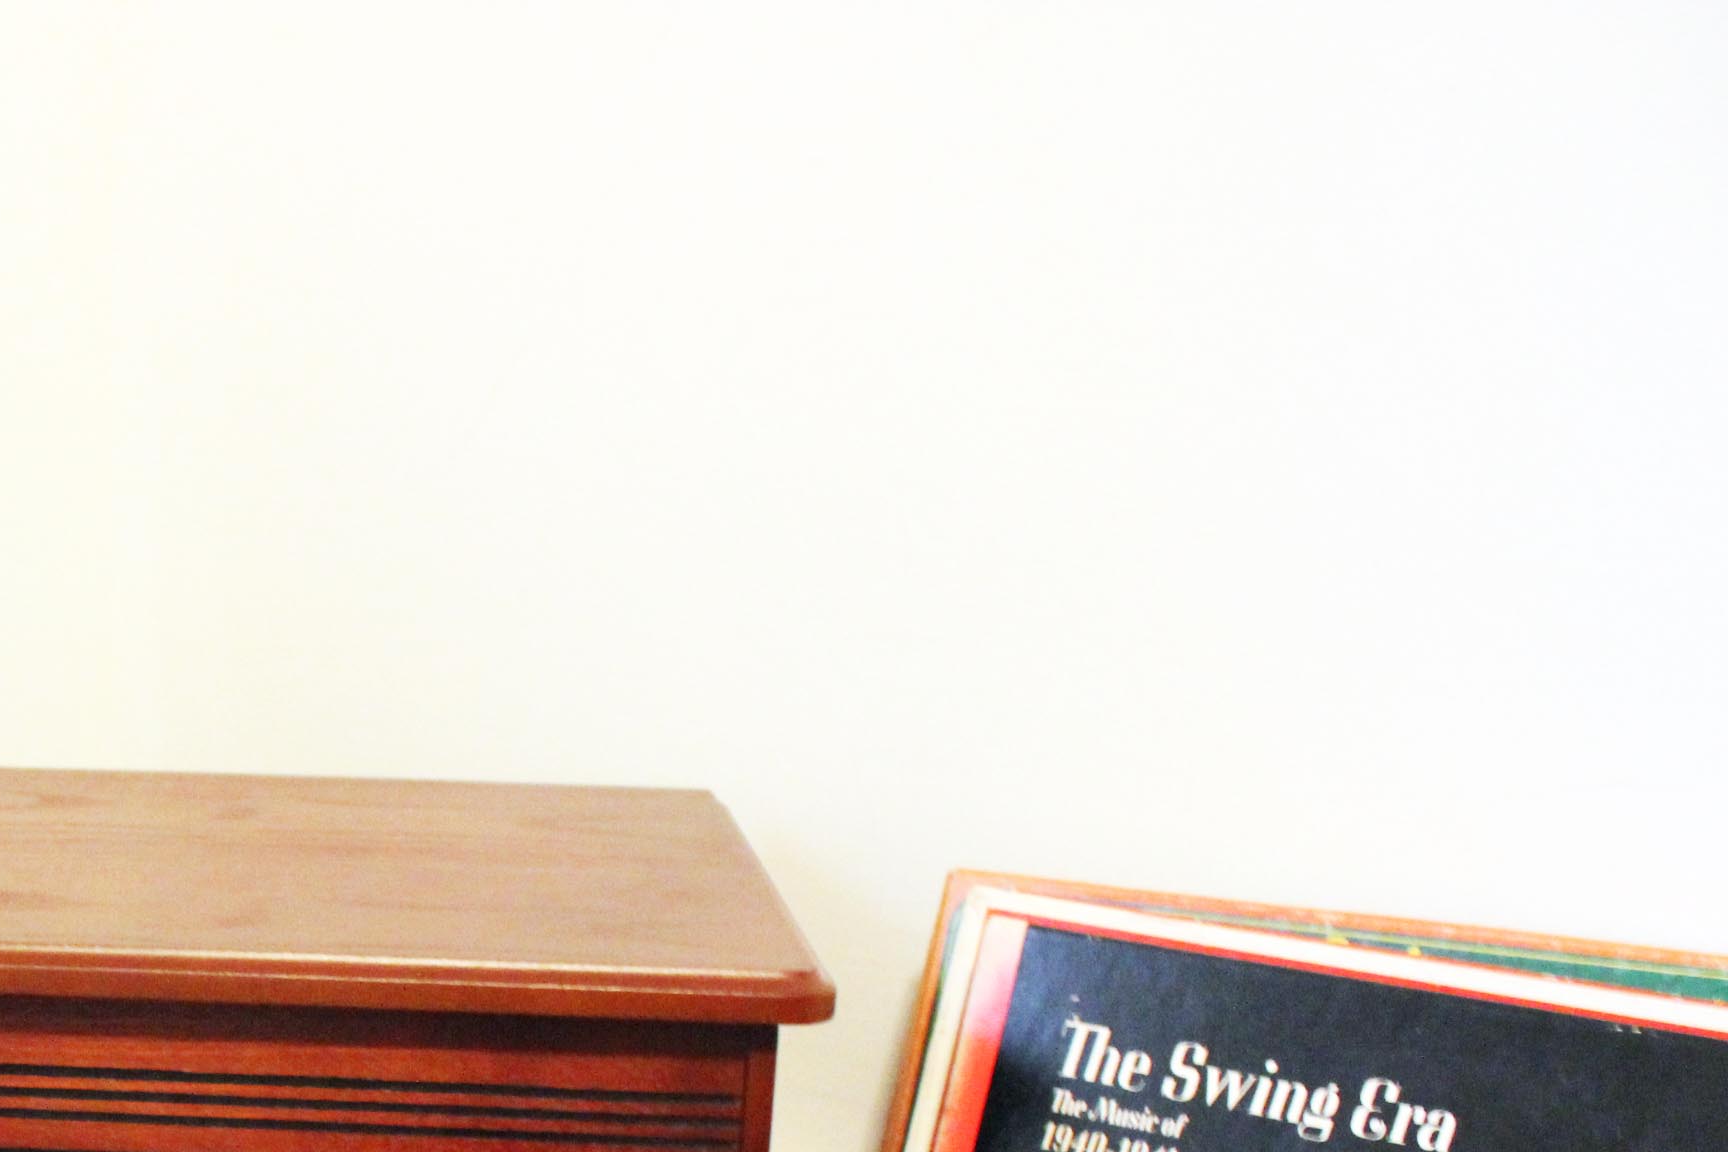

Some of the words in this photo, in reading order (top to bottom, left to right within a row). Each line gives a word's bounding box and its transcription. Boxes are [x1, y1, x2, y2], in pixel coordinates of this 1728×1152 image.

[1051, 1087, 1088, 1118] The
[1087, 1096, 1160, 1133] Music
[1160, 1113, 1190, 1138] of
[1059, 1015, 1152, 1093] The
[1160, 1039, 1340, 1143] Swing
